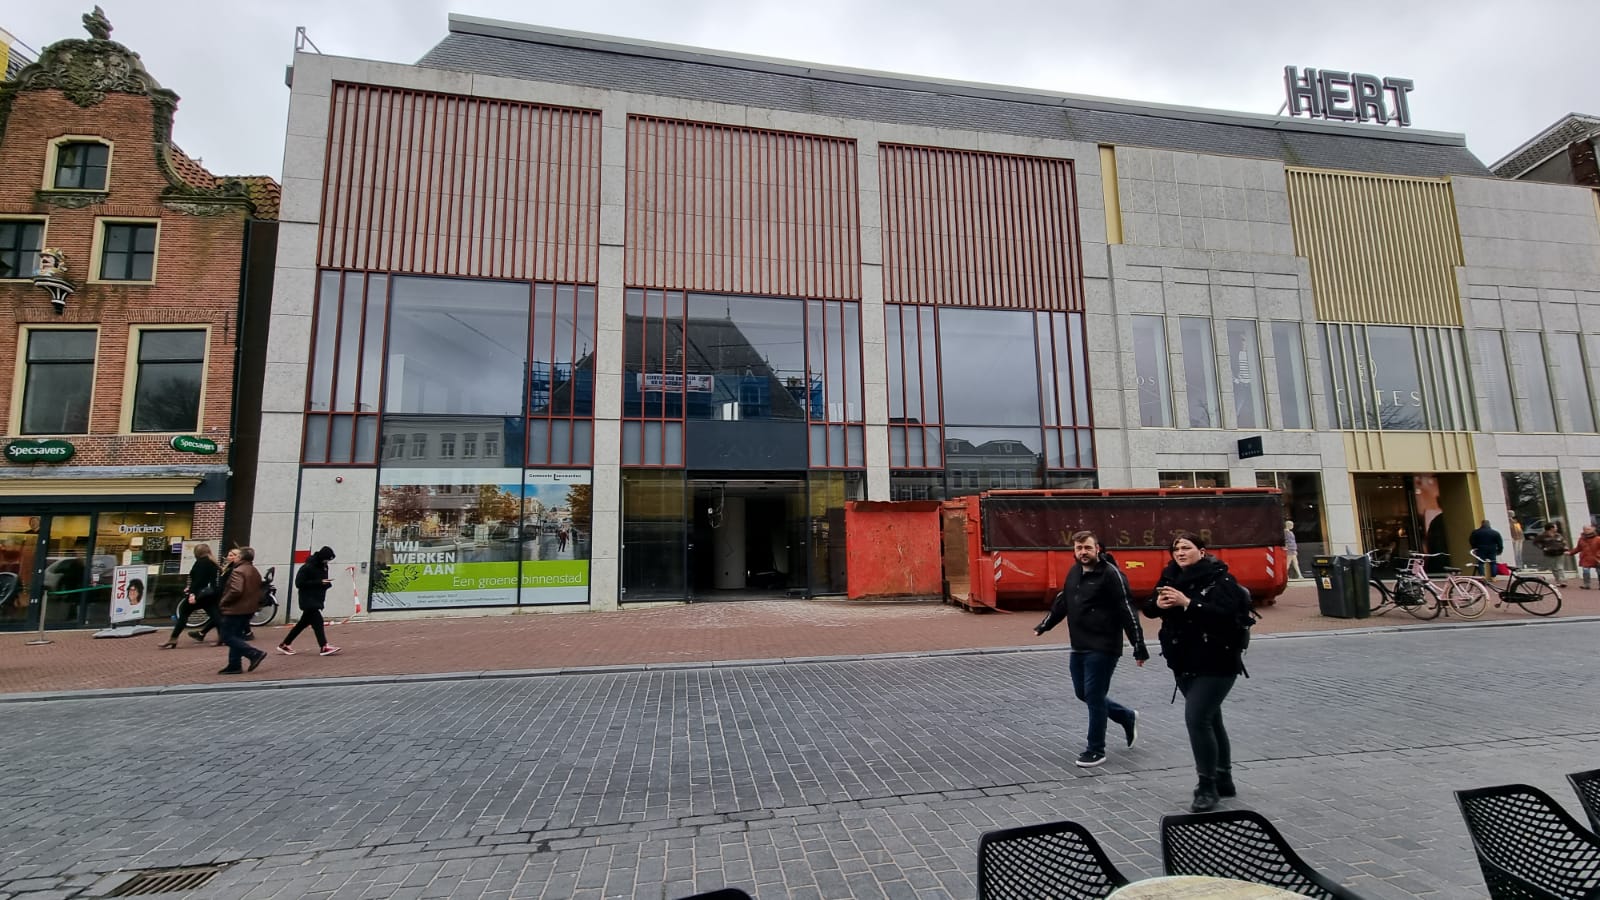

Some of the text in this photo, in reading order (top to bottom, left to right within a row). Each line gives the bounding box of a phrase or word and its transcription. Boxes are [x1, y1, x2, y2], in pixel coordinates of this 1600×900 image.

[1284, 65, 1414, 126] HERT
[180, 439, 215, 450] Specsavers
[9, 445, 66, 456] Specsavers
[118, 524, 164, 534] Opticiens
[392, 552, 456, 563] WERKEN
[423, 564, 455, 575] AAN
[116, 569, 127, 599] SALE
[453, 572, 582, 588] Een groene binnenstad
